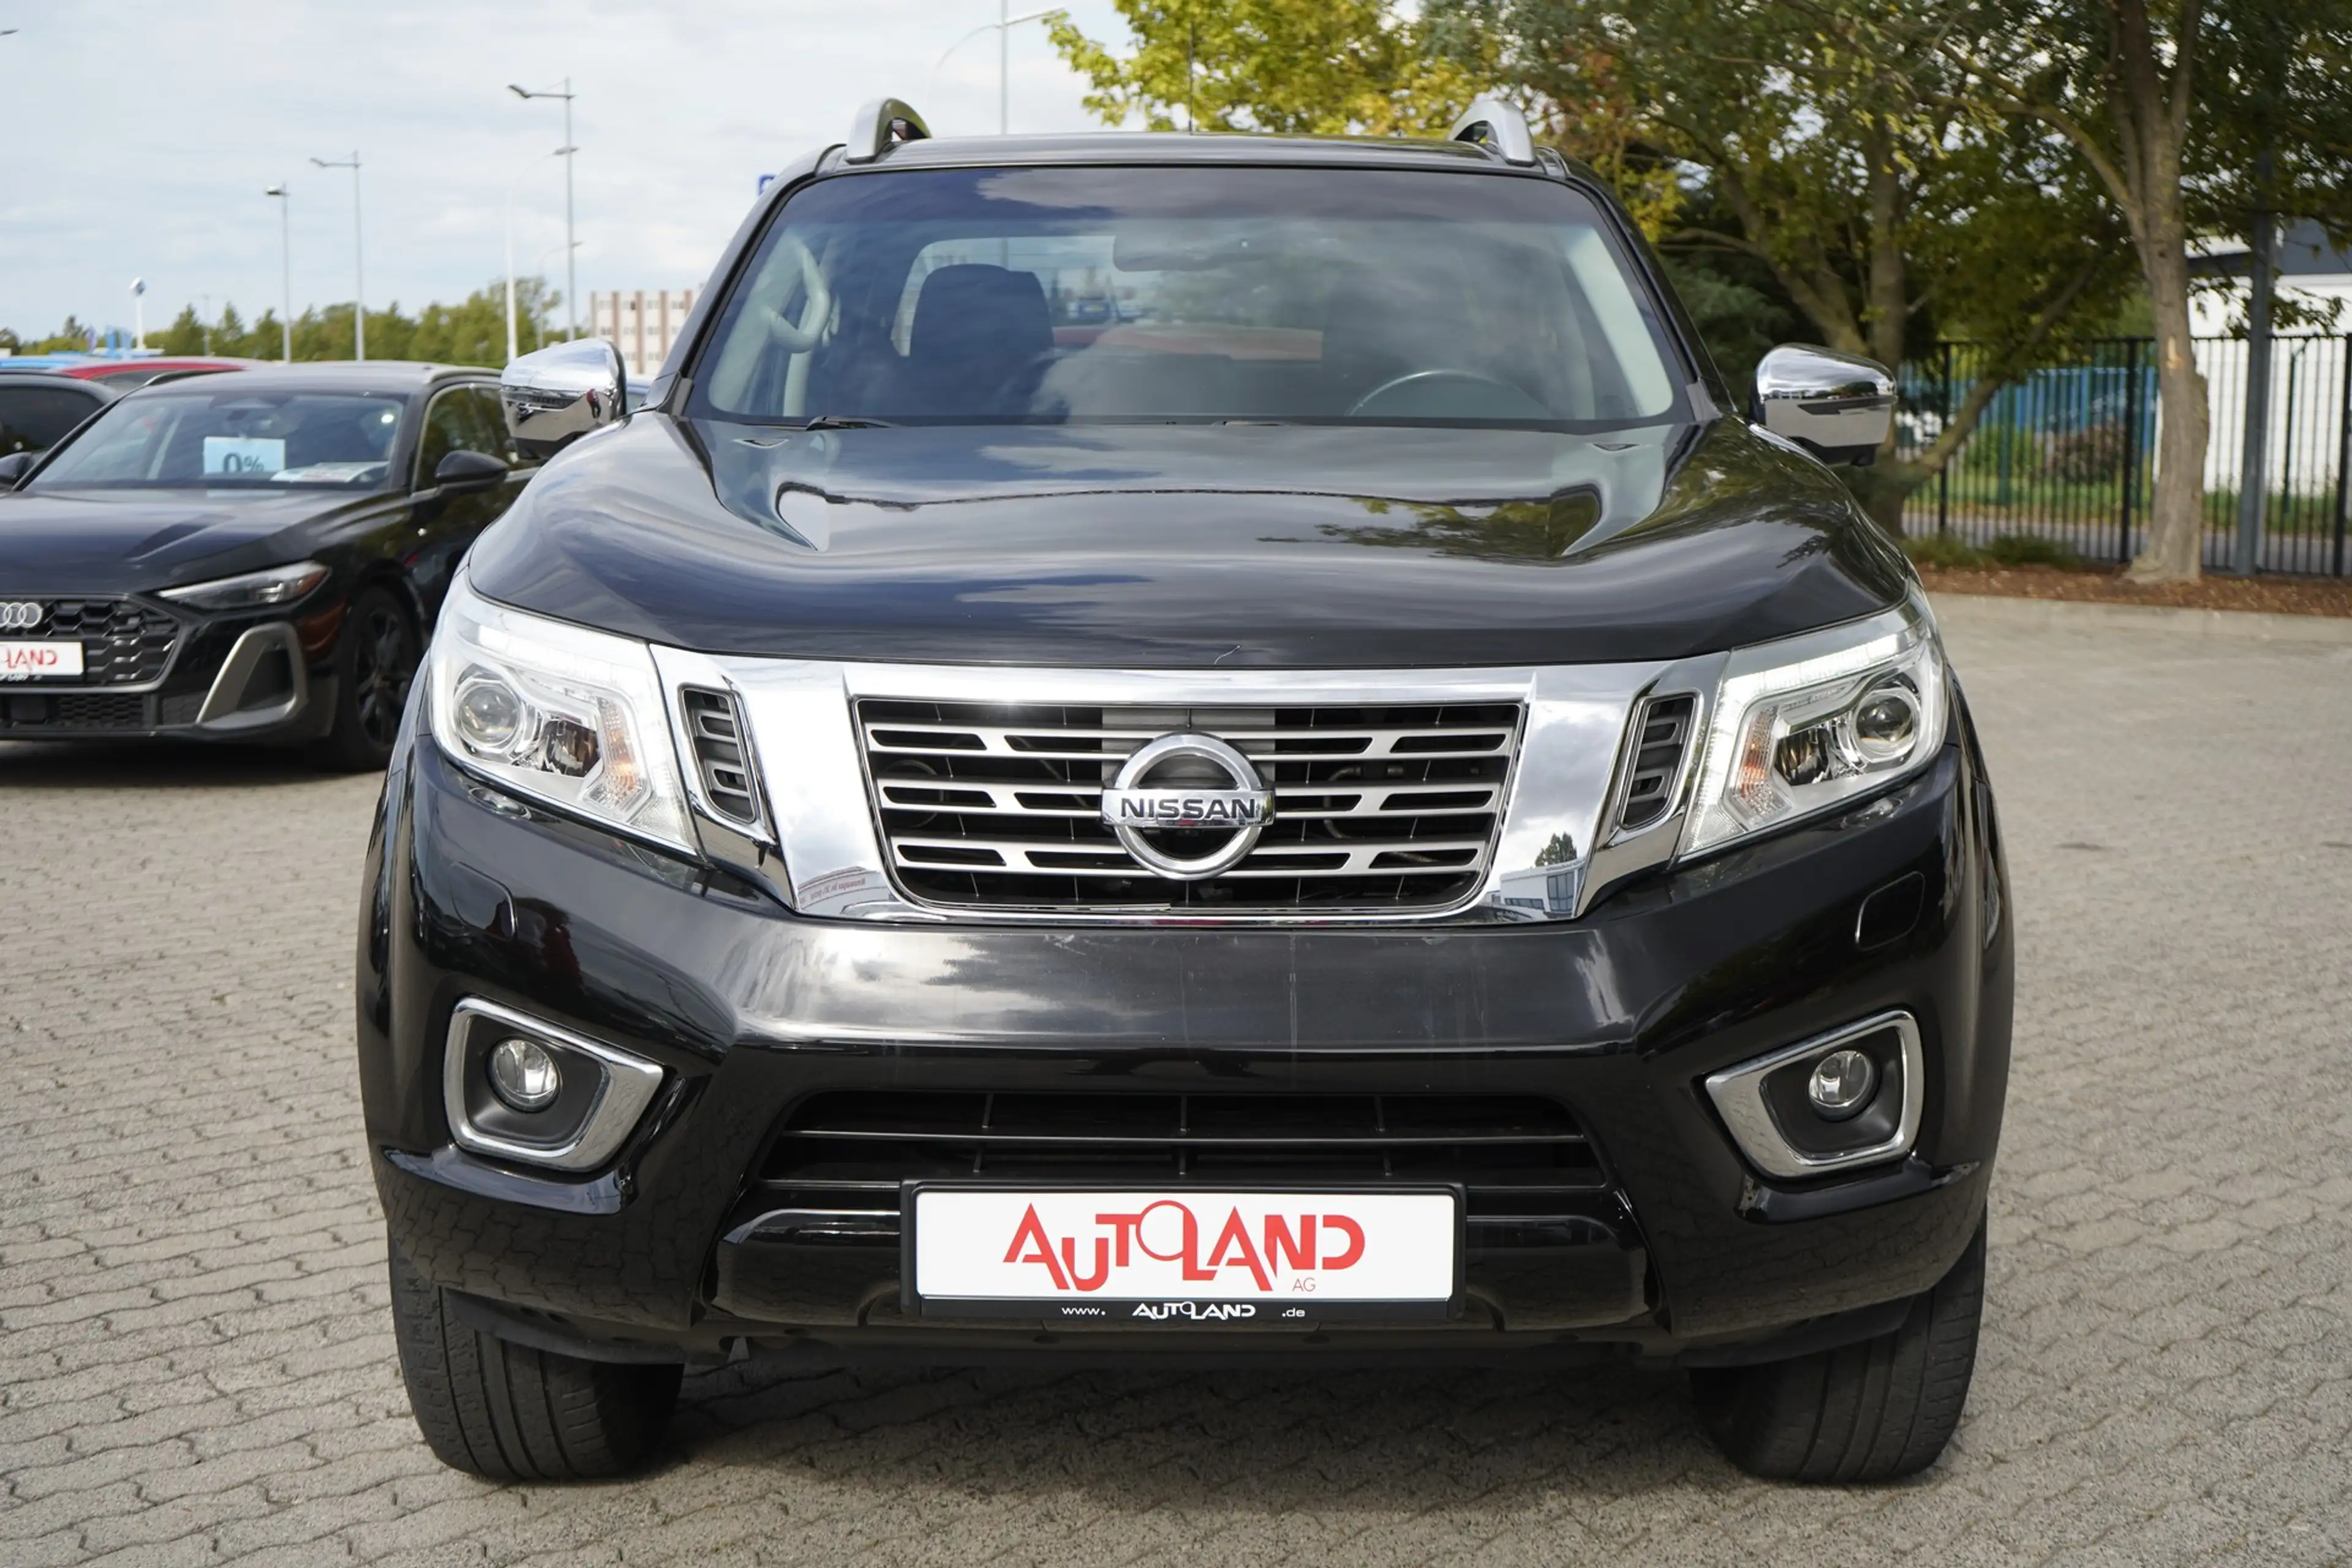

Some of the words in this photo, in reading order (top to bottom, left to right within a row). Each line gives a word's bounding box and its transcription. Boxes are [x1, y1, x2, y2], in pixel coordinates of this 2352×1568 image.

[1120, 797, 1256, 820] NISSAN
[1292, 1277, 1316, 1292] AG
[1281, 1308, 1305, 1317] .de
